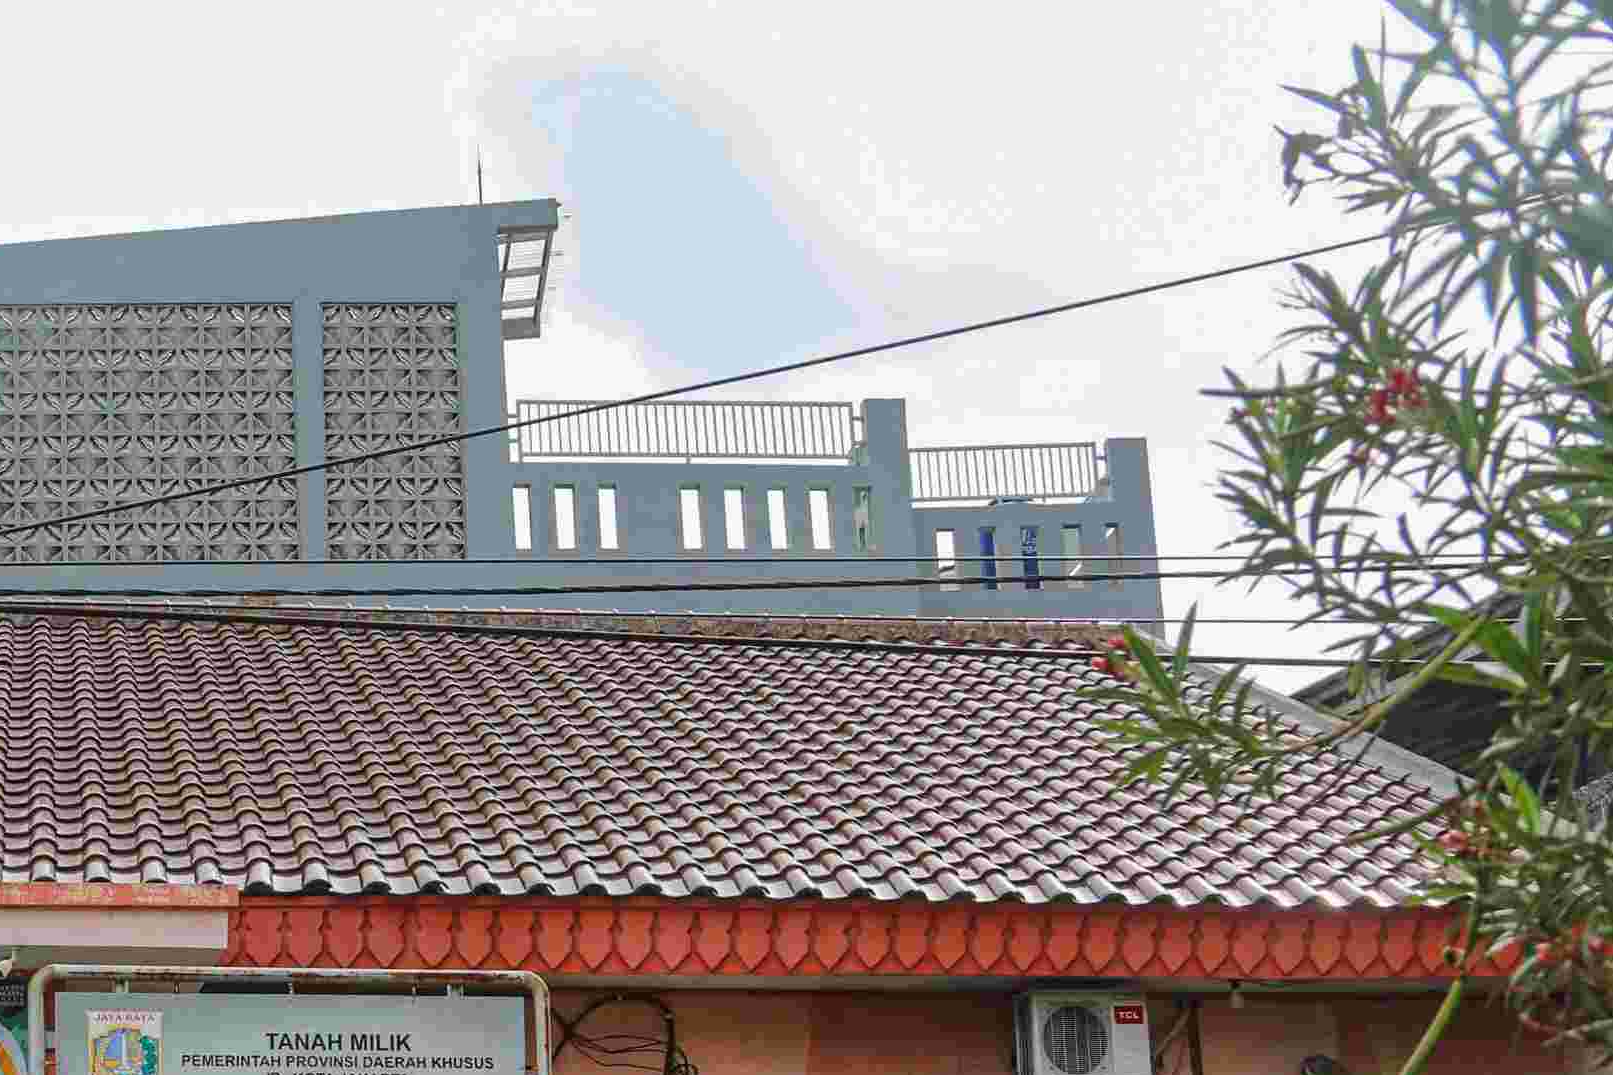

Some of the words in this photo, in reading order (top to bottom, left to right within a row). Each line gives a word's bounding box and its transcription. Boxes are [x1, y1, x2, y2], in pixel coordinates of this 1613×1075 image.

[1117, 1011, 1139, 1020] TCL
[265, 1033, 343, 1051] TANAH
[350, 1034, 412, 1051] MILIK
[181, 1055, 281, 1067] PEMERINTAH
[286, 1055, 358, 1068] PROVINSI
[363, 1056, 427, 1069] DAERAH
[431, 1057, 494, 1069] KHUSUS
